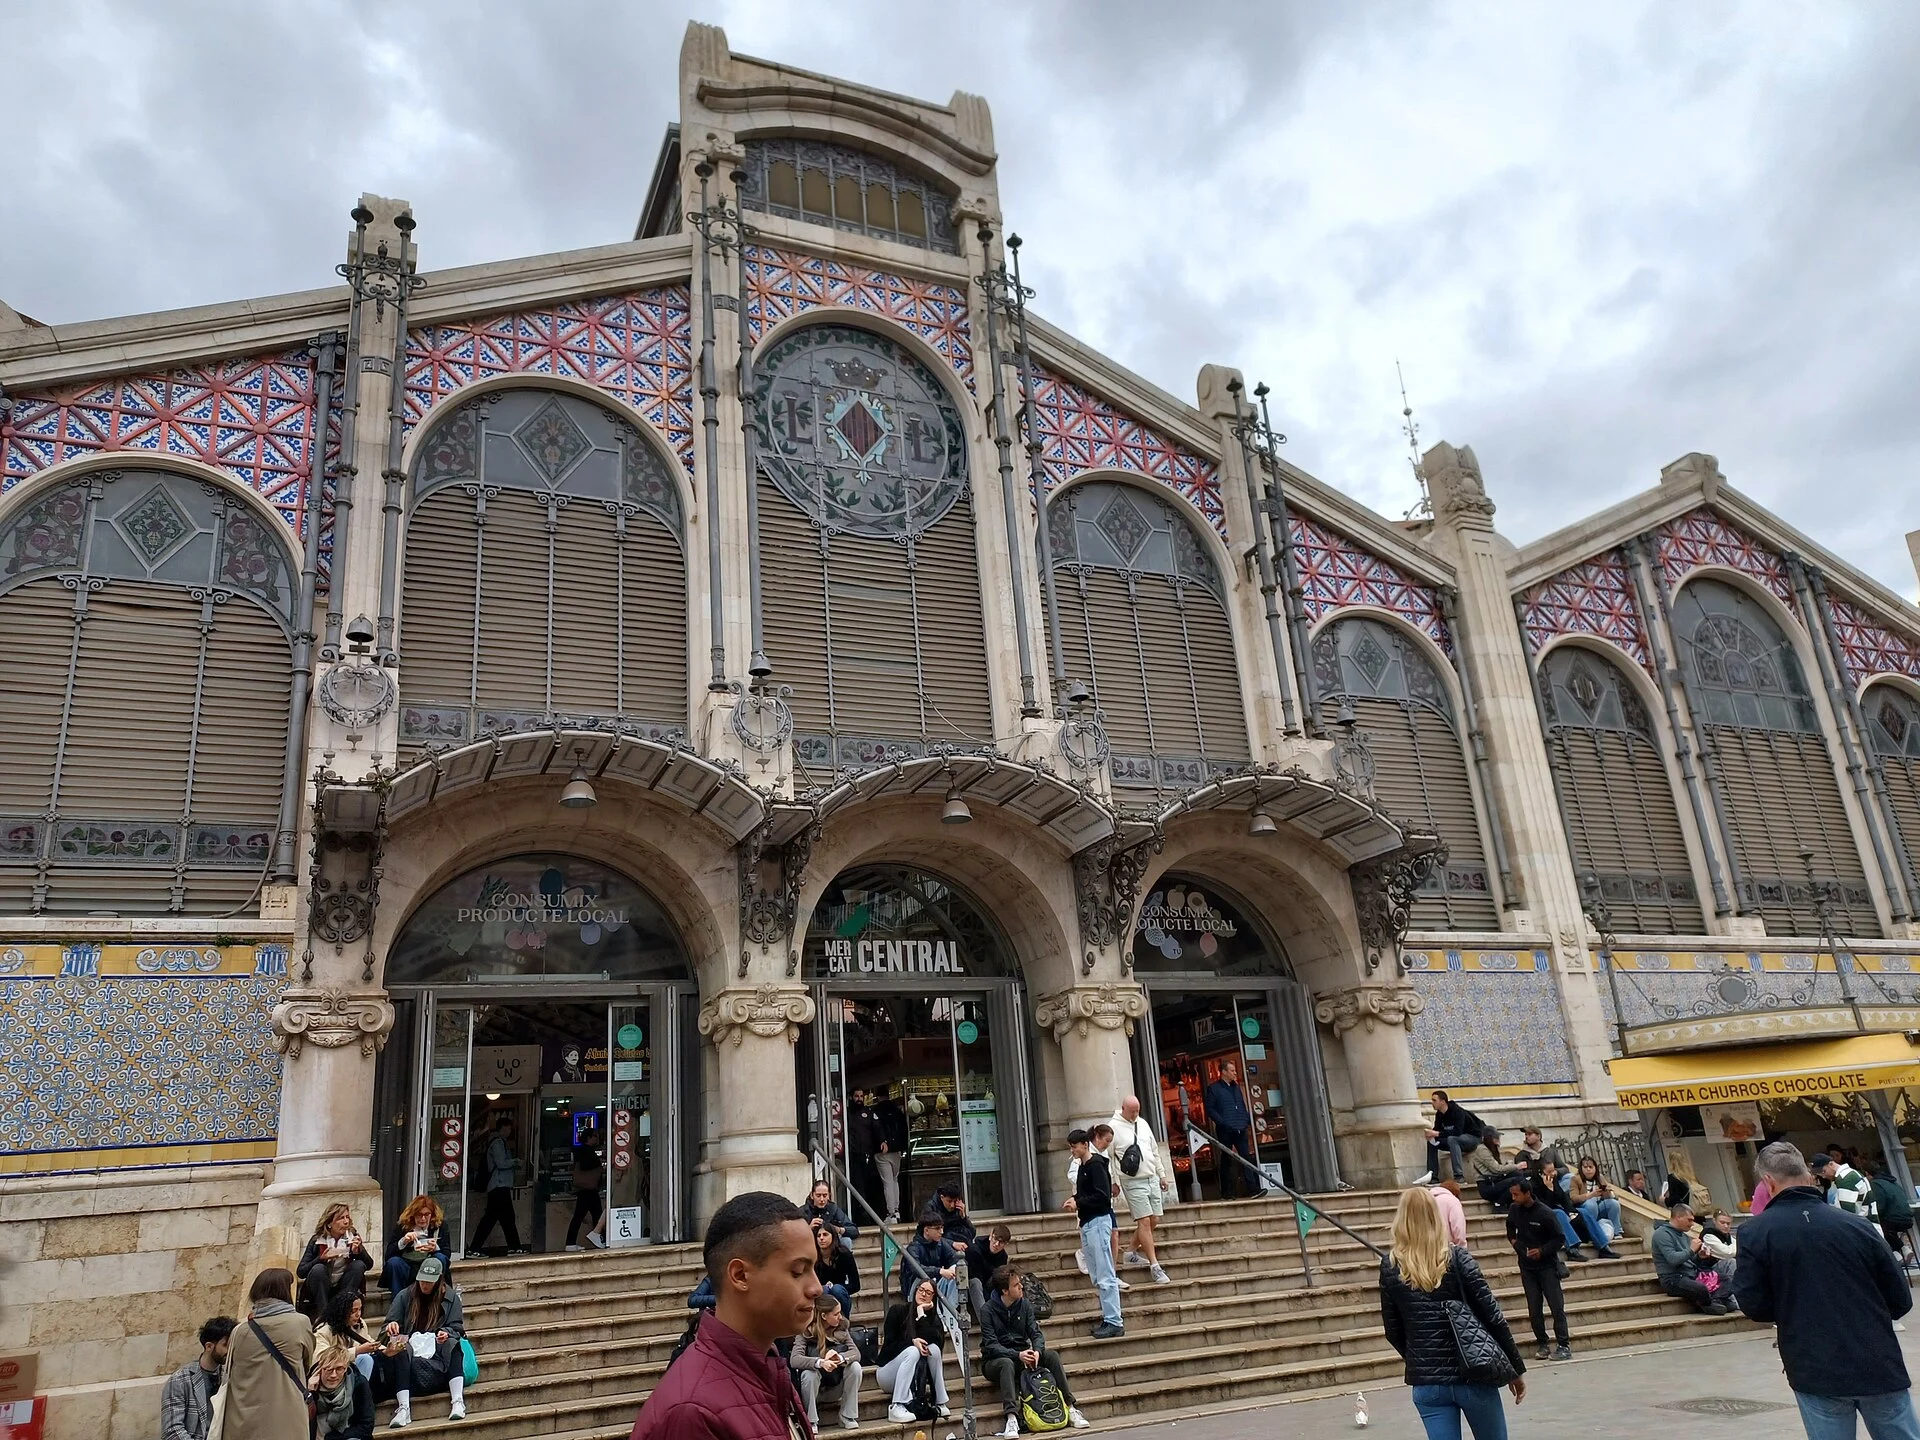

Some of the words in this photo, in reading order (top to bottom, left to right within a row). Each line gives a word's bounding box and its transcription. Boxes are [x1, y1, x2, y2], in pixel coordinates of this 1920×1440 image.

[491, 893, 599, 908] CONSUMIX
[457, 908, 563, 923] PRODUCTE
[567, 909, 630, 924] LOCAL
[1141, 905, 1214, 918] CONSUMIX
[1136, 917, 1192, 931] ODUCTE
[1194, 919, 1238, 932] LOCAL
[824, 940, 851, 957] MER
[857, 940, 964, 973] CENTRAL
[829, 956, 852, 973] CAT
[1619, 1089, 1696, 1107] HORCHATA
[1699, 1082, 1770, 1101] CHURROS
[1773, 1073, 1867, 1094] CHOCOLATE
